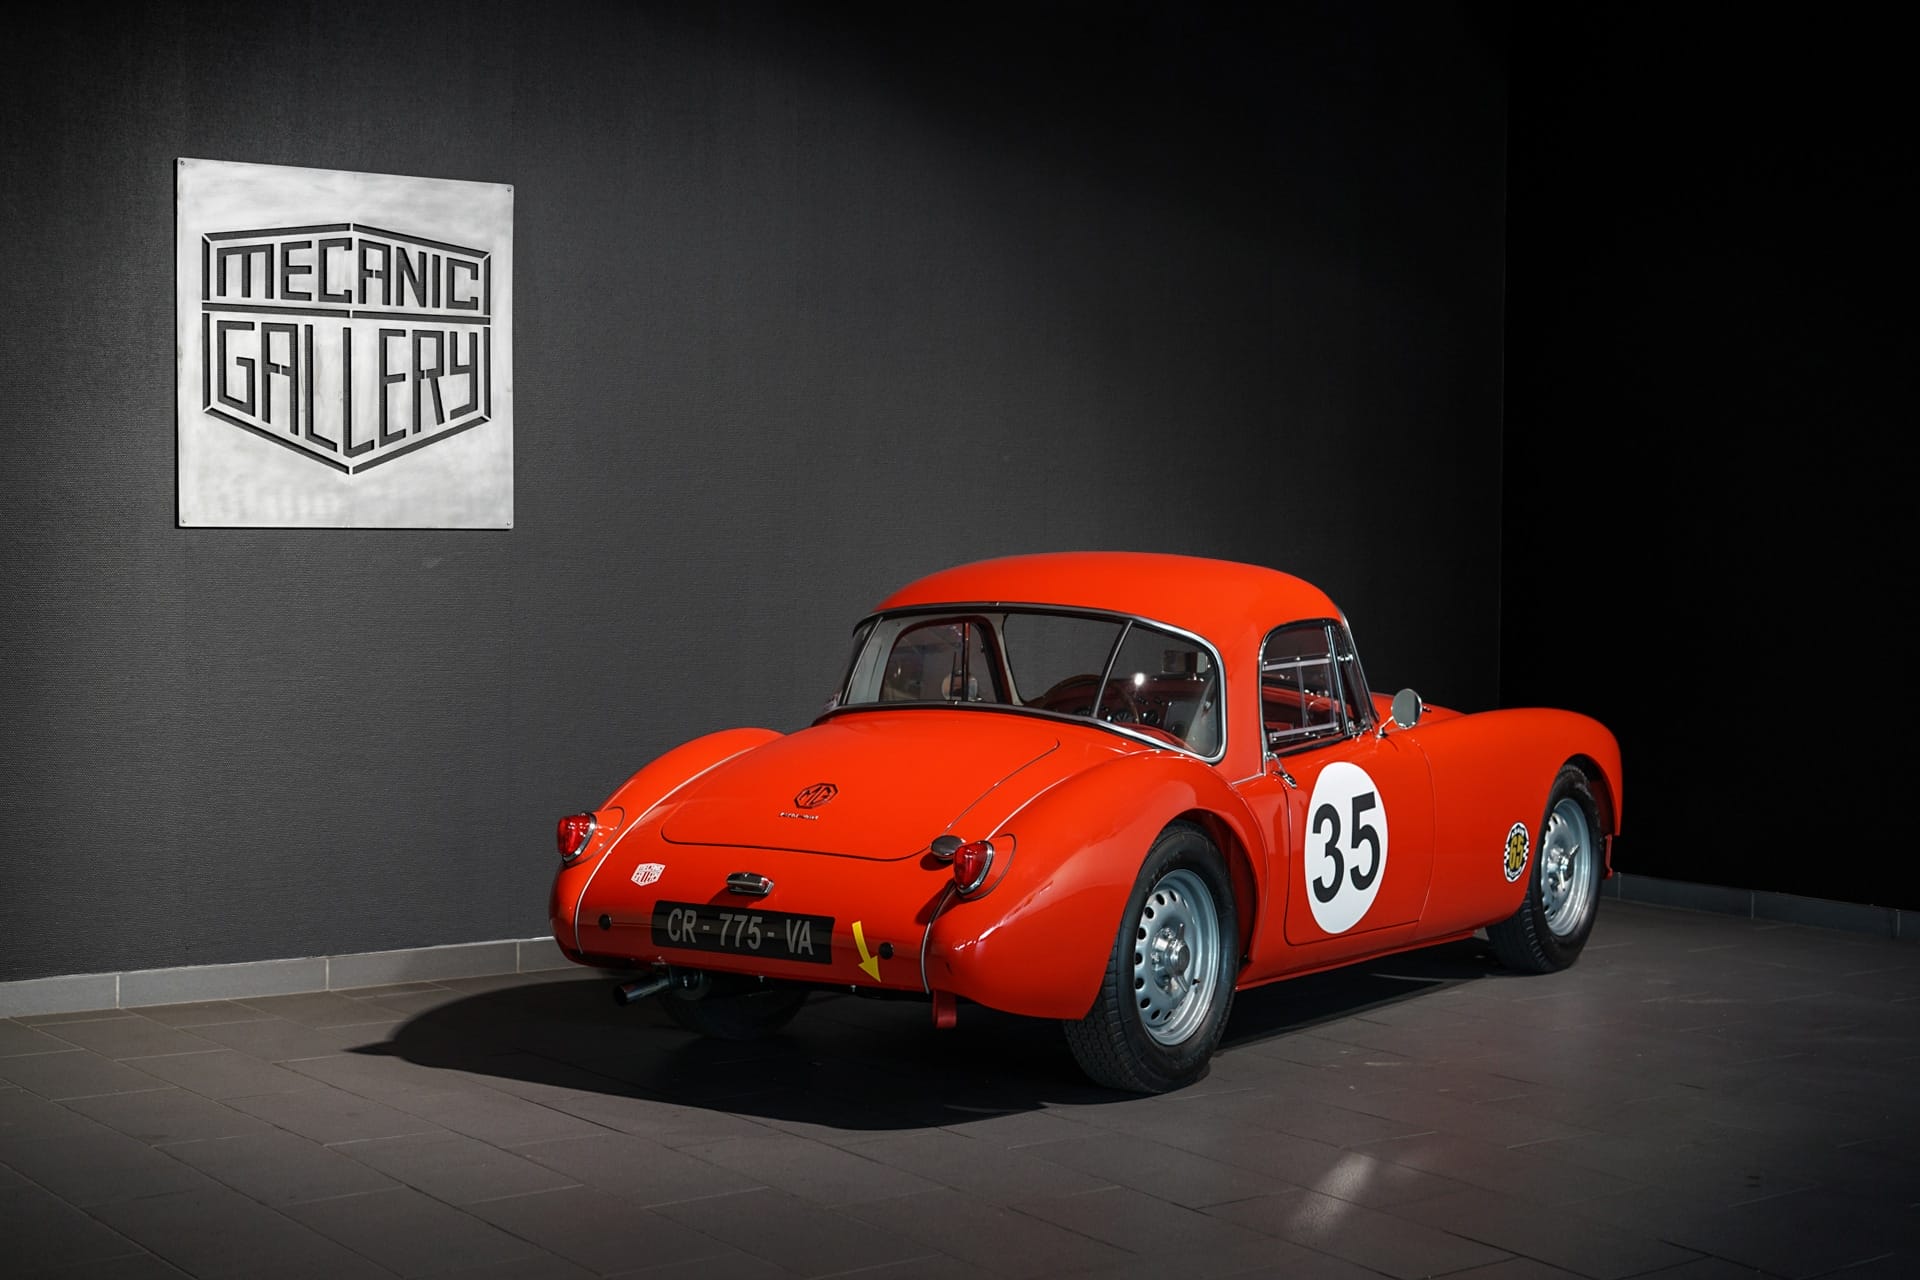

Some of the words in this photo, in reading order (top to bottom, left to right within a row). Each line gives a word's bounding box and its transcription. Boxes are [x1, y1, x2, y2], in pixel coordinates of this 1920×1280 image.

[216, 237, 479, 309] MECANIC
[216, 320, 479, 459] GALLERY
[798, 785, 833, 806] MG
[1312, 791, 1381, 904] 35
